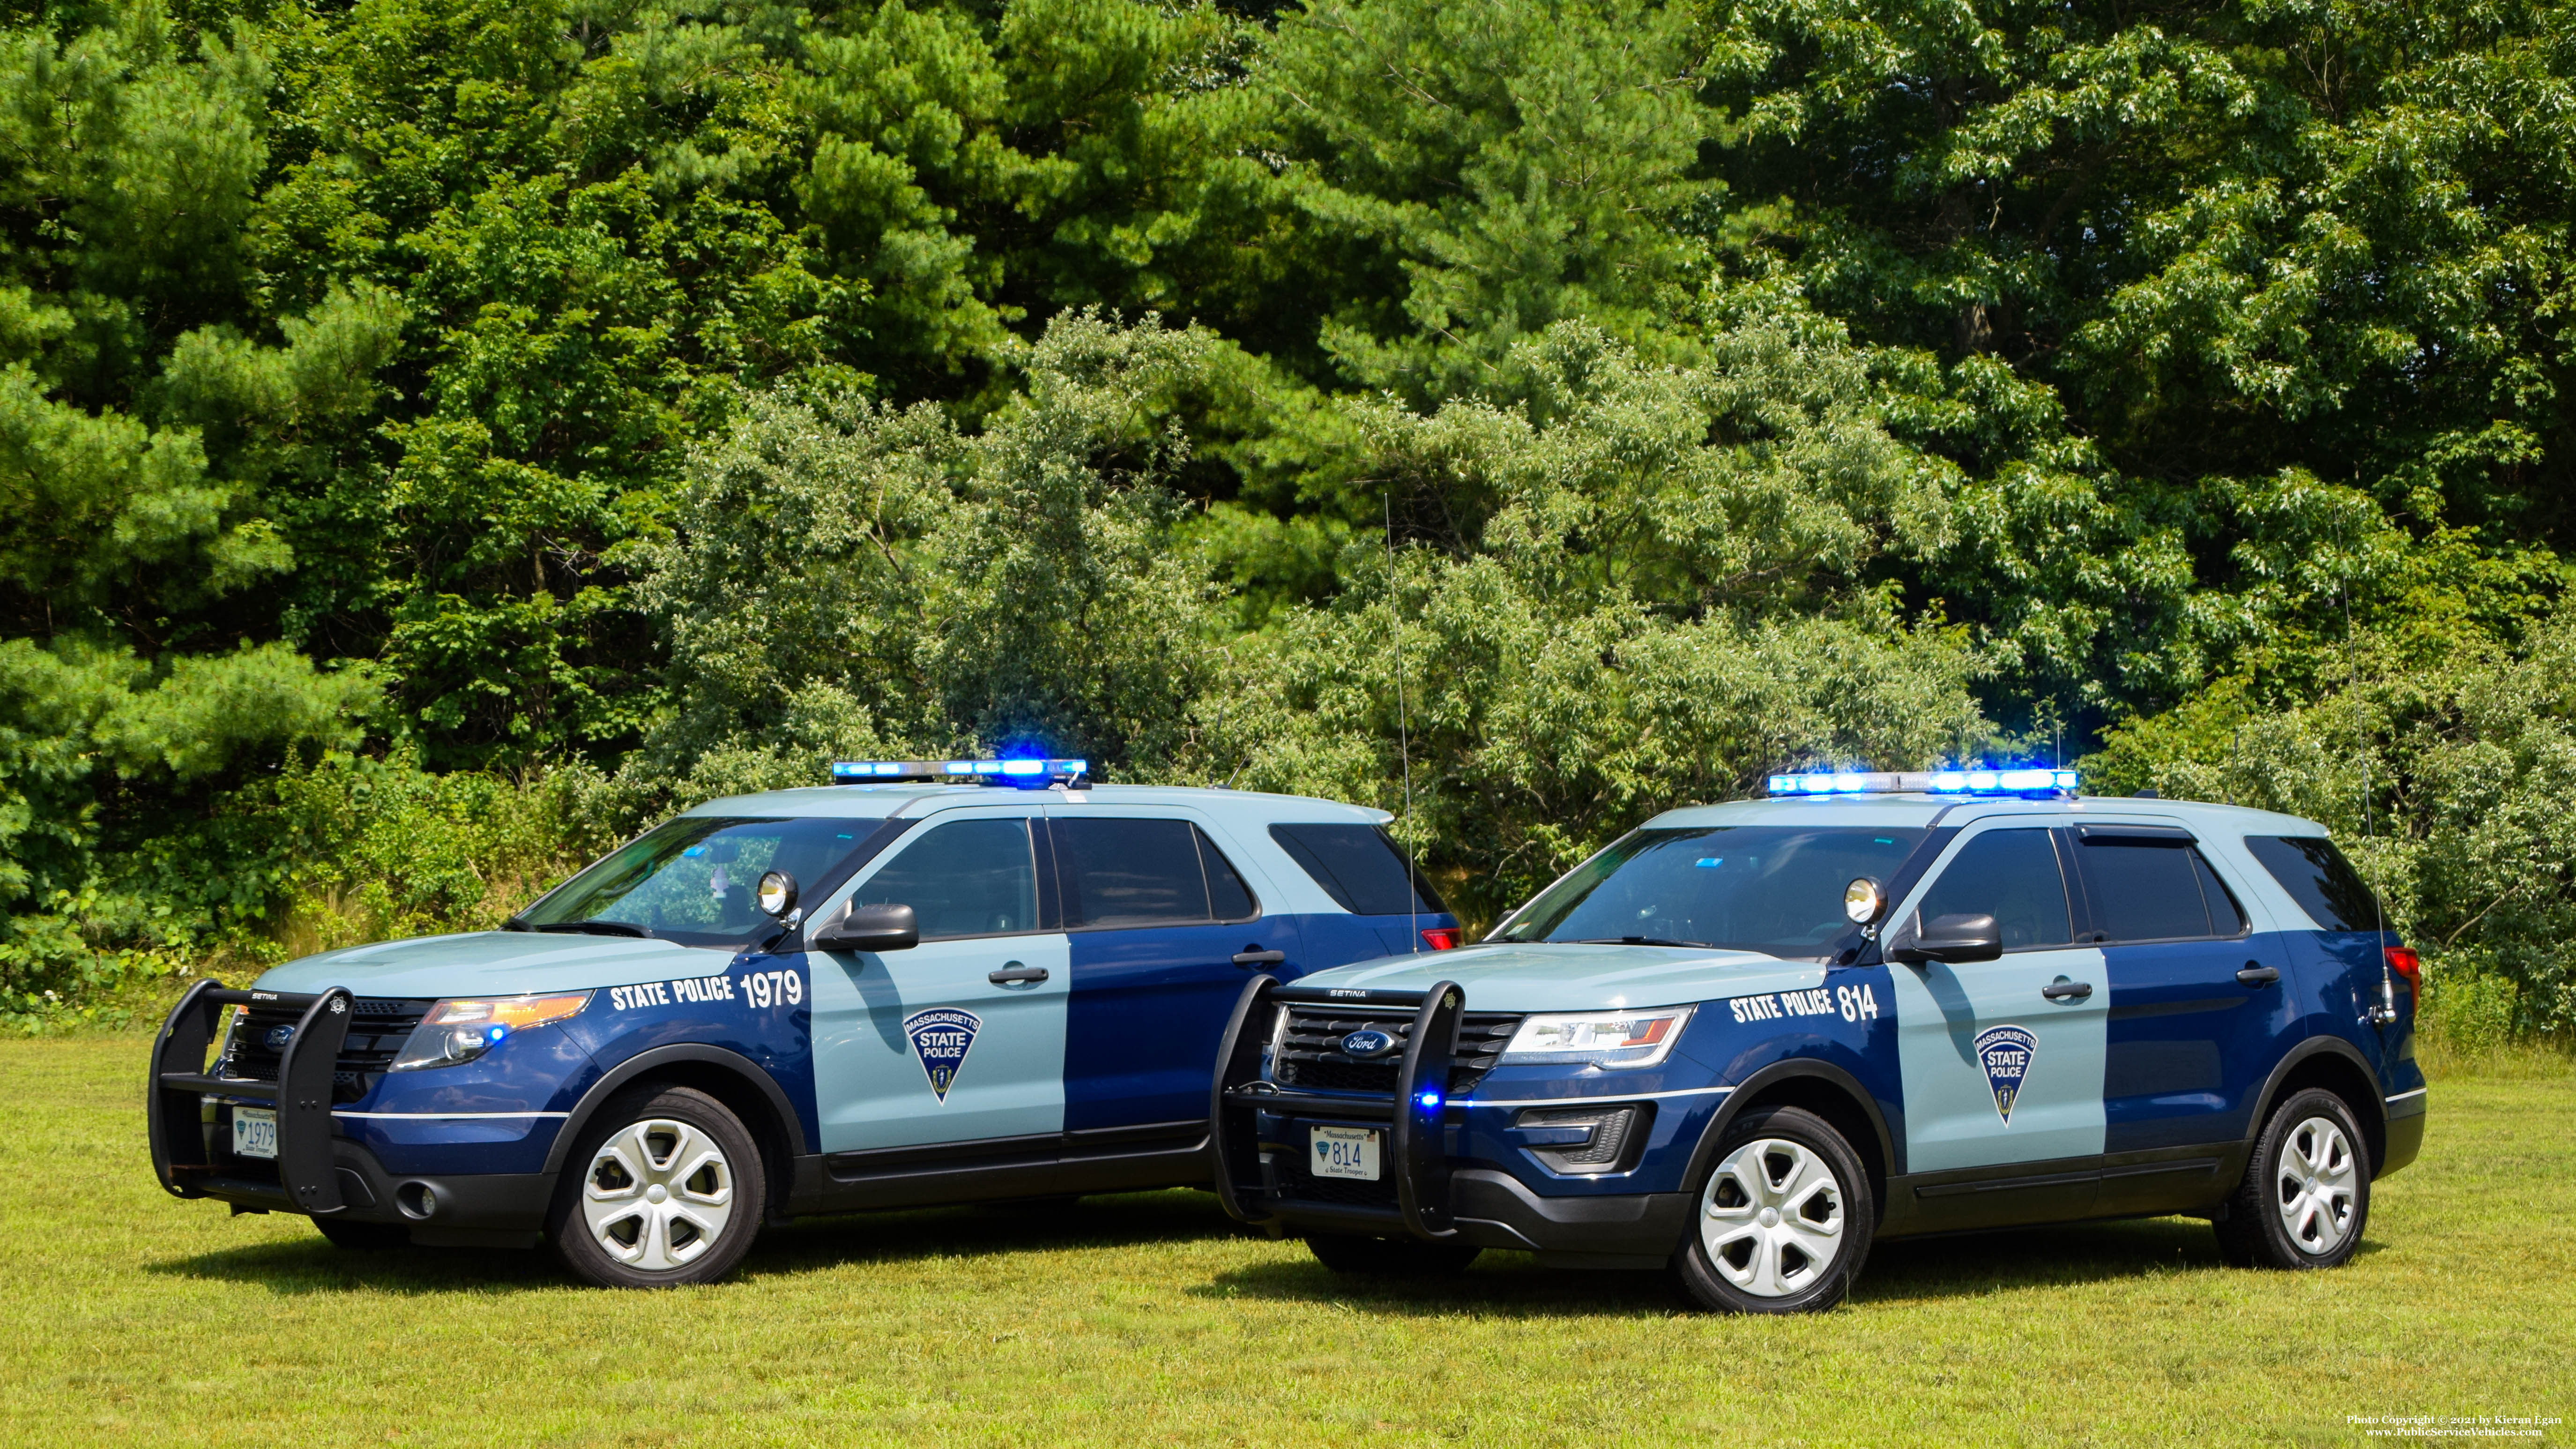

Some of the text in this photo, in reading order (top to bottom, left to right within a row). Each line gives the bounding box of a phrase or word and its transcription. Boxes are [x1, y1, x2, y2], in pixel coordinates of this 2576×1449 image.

[610, 969, 802, 1011] STATE POLICE 1979
[1729, 984, 1877, 1023] STATE POLICE 814
[906, 1013, 979, 1032] MASSACHUSETTS
[920, 1032, 966, 1046] STATE
[1349, 1034, 1378, 1049] Ford
[1976, 1031, 2035, 1050] MASSACHUSETTS
[923, 1047, 961, 1058] POLICE
[1987, 1051, 2025, 1066] STATE
[1990, 1067, 2021, 1078] POLICE
[248, 1121, 274, 1146] 1979
[1326, 1130, 1364, 1140] Massachusetts
[1333, 1142, 1361, 1167] 814
[1344, 1167, 1363, 1176] Trooper
